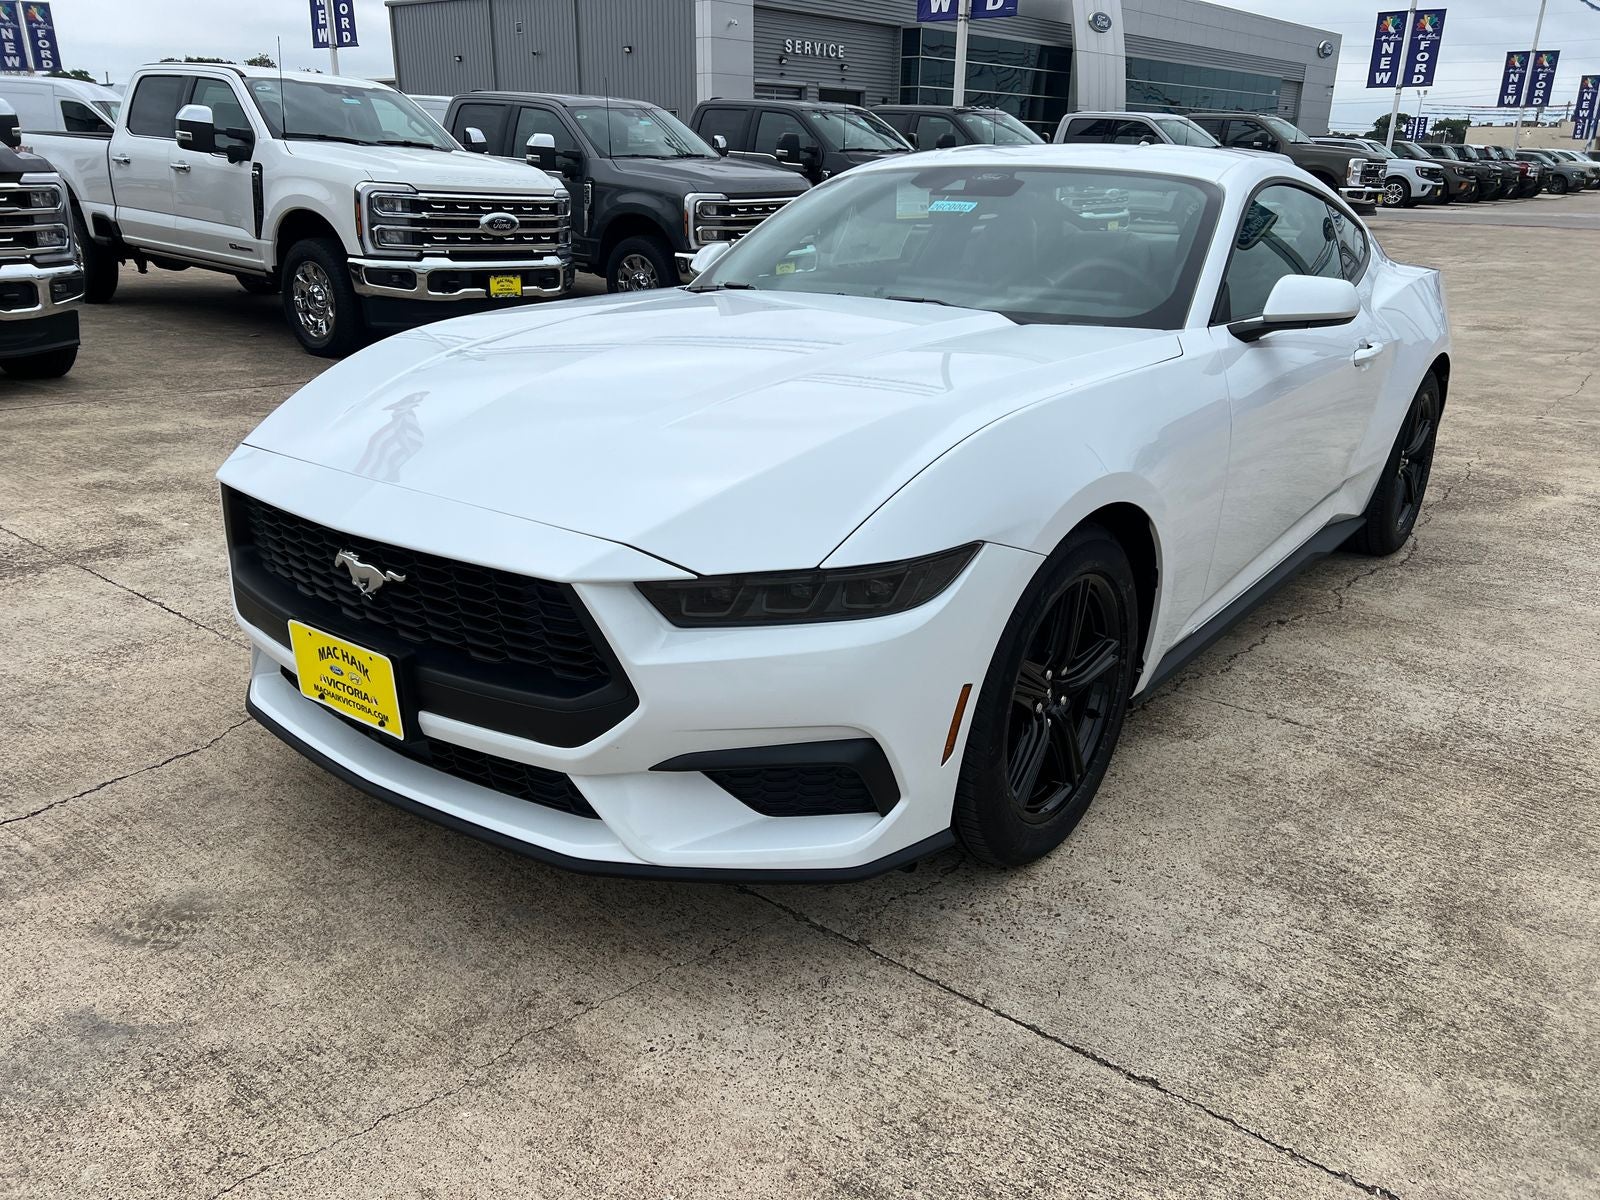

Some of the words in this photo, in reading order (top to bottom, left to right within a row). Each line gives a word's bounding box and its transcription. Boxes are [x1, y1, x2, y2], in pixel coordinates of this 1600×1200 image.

[339, 3, 351, 43] ORD
[1, 28, 20, 67] NEW
[37, 29, 53, 68] FORD
[785, 39, 845, 58] SERVICE
[1375, 42, 1395, 84] NEW
[1412, 41, 1430, 84] FORD
[1503, 73, 1519, 105] NEW
[1532, 73, 1547, 105] FORD
[1579, 92, 1592, 118] NEW
[493, 219, 511, 229] Ford
[318, 646, 340, 661] MAC
[340, 649, 371, 683] HAIK
[313, 683, 389, 722] MACHAIKVICTORIA.COM
[325, 676, 371, 703] VICTORIA
